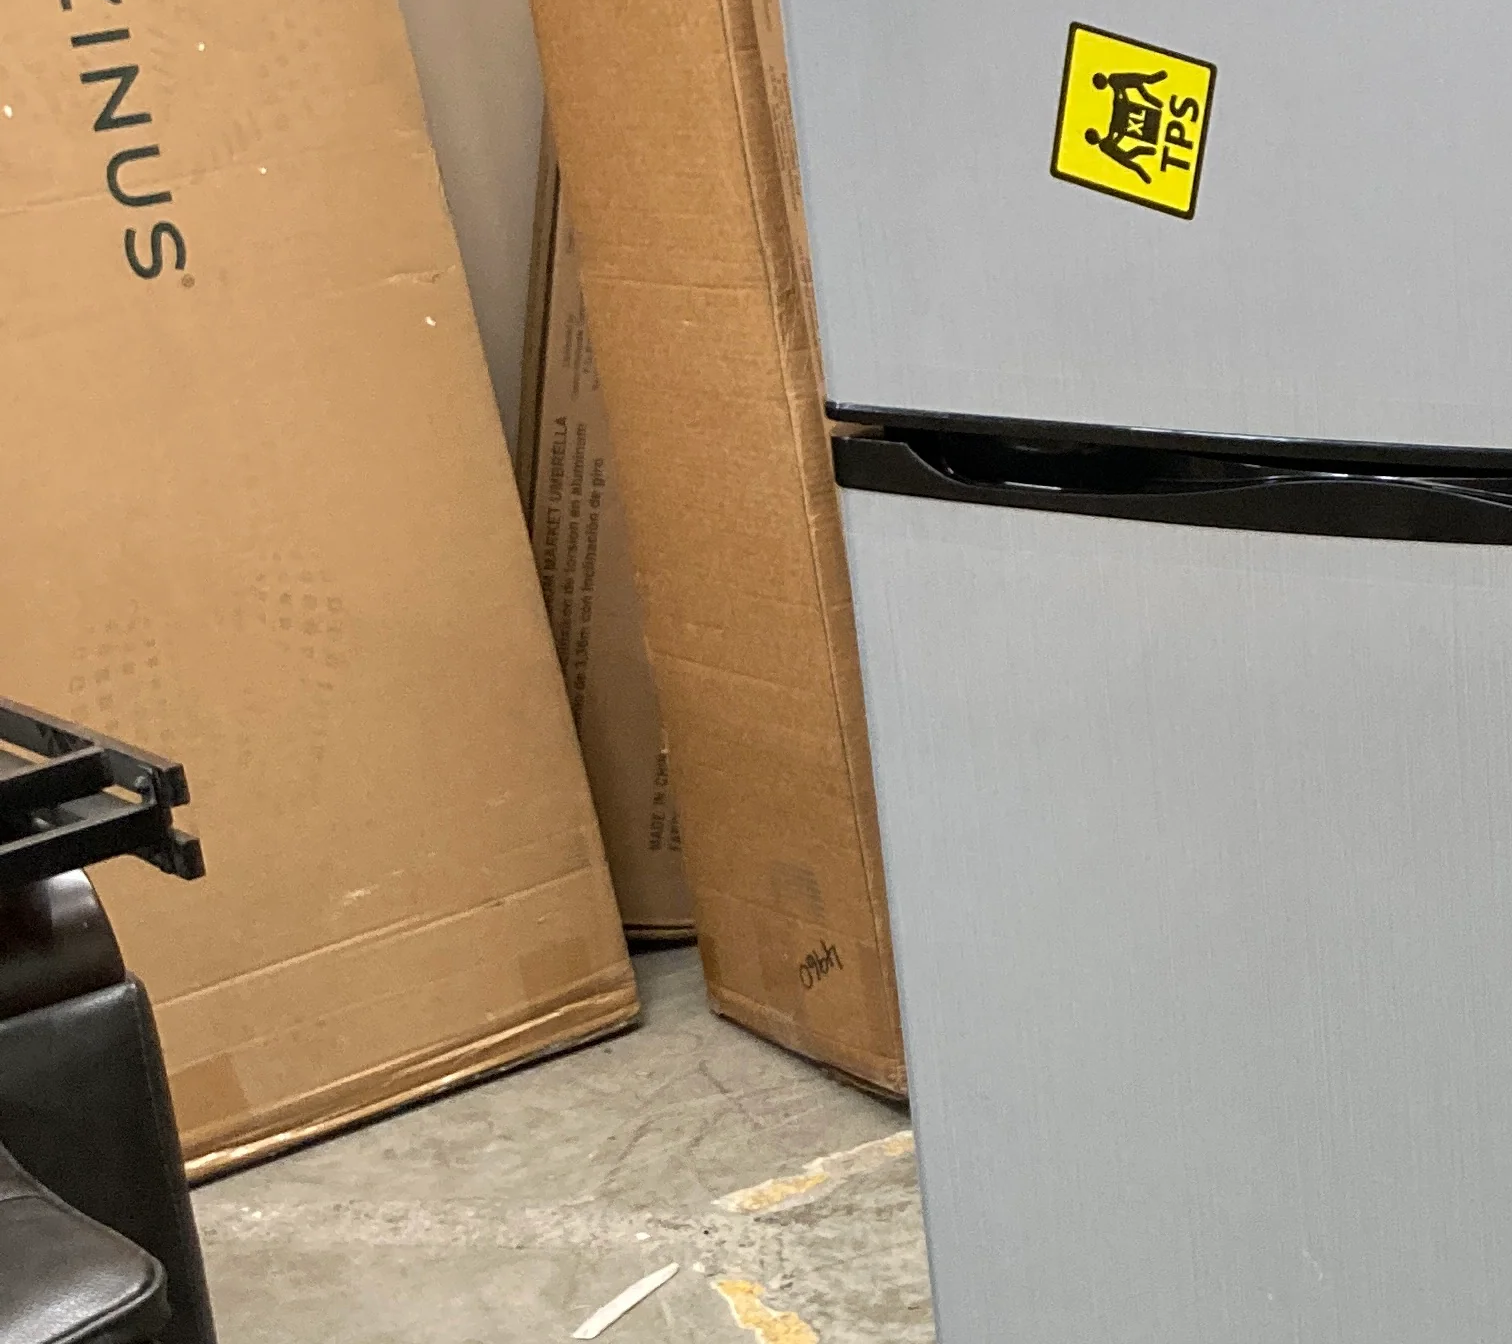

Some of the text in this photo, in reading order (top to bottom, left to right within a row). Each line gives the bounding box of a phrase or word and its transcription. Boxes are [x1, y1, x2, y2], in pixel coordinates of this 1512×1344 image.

[1126, 109, 1147, 136] XL
[1160, 94, 1200, 172] TPS
[548, 416, 568, 502] UMBRELLA
[543, 508, 562, 570] MARKET
